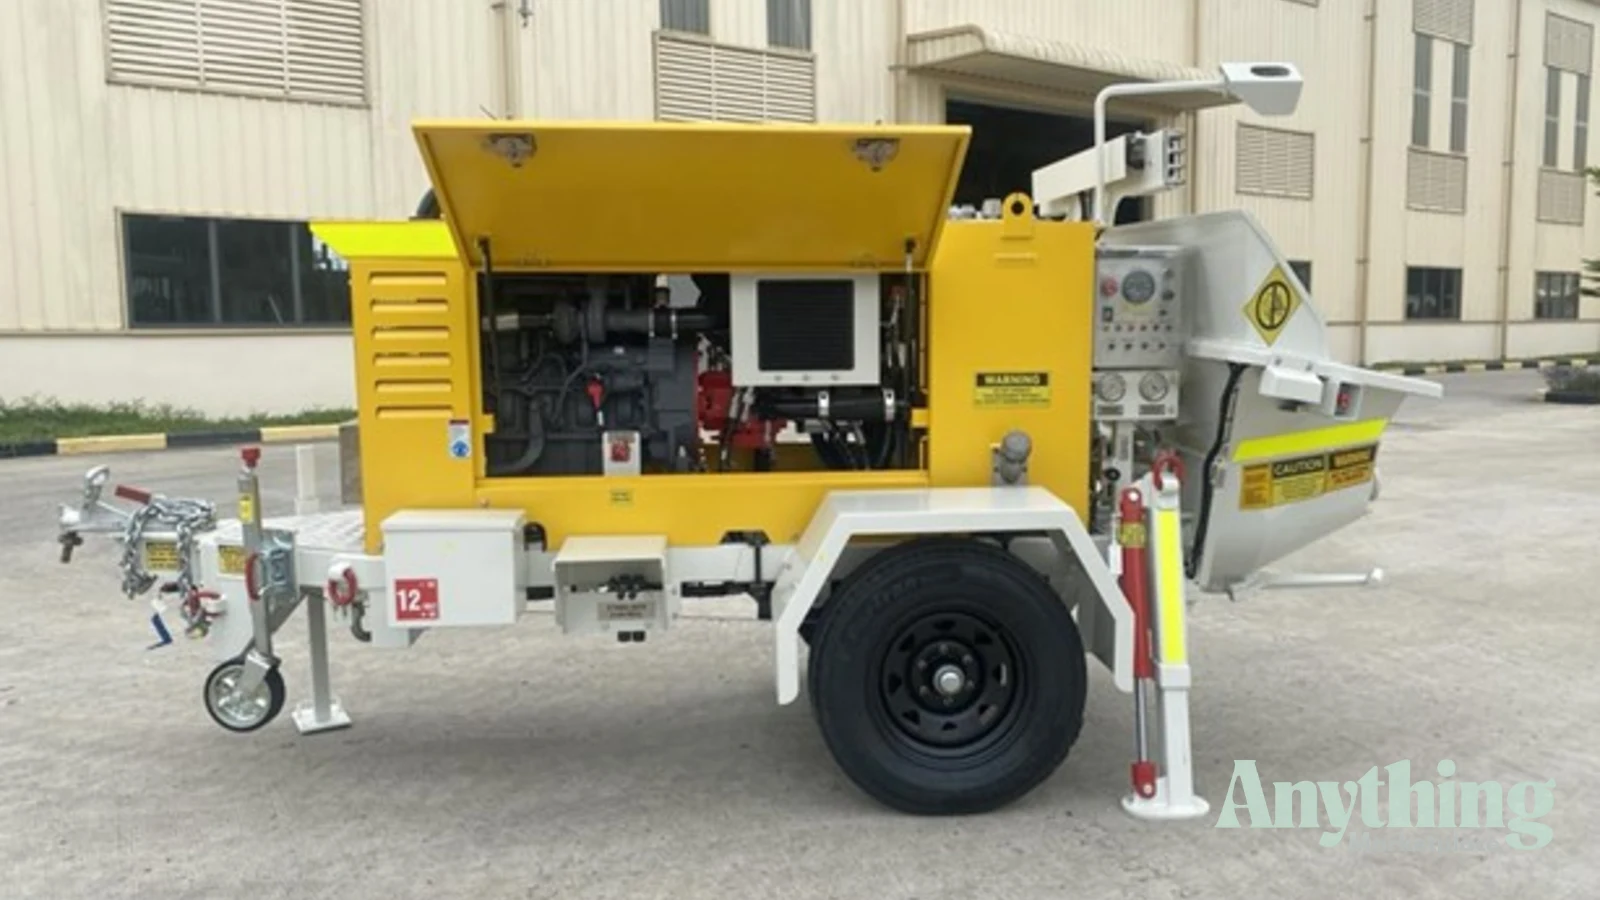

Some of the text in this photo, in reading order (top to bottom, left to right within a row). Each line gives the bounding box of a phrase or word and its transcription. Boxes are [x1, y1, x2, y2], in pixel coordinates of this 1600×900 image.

[984, 373, 1041, 385] WARNING
[1274, 458, 1323, 475] CAUTION
[396, 588, 421, 612] 12
